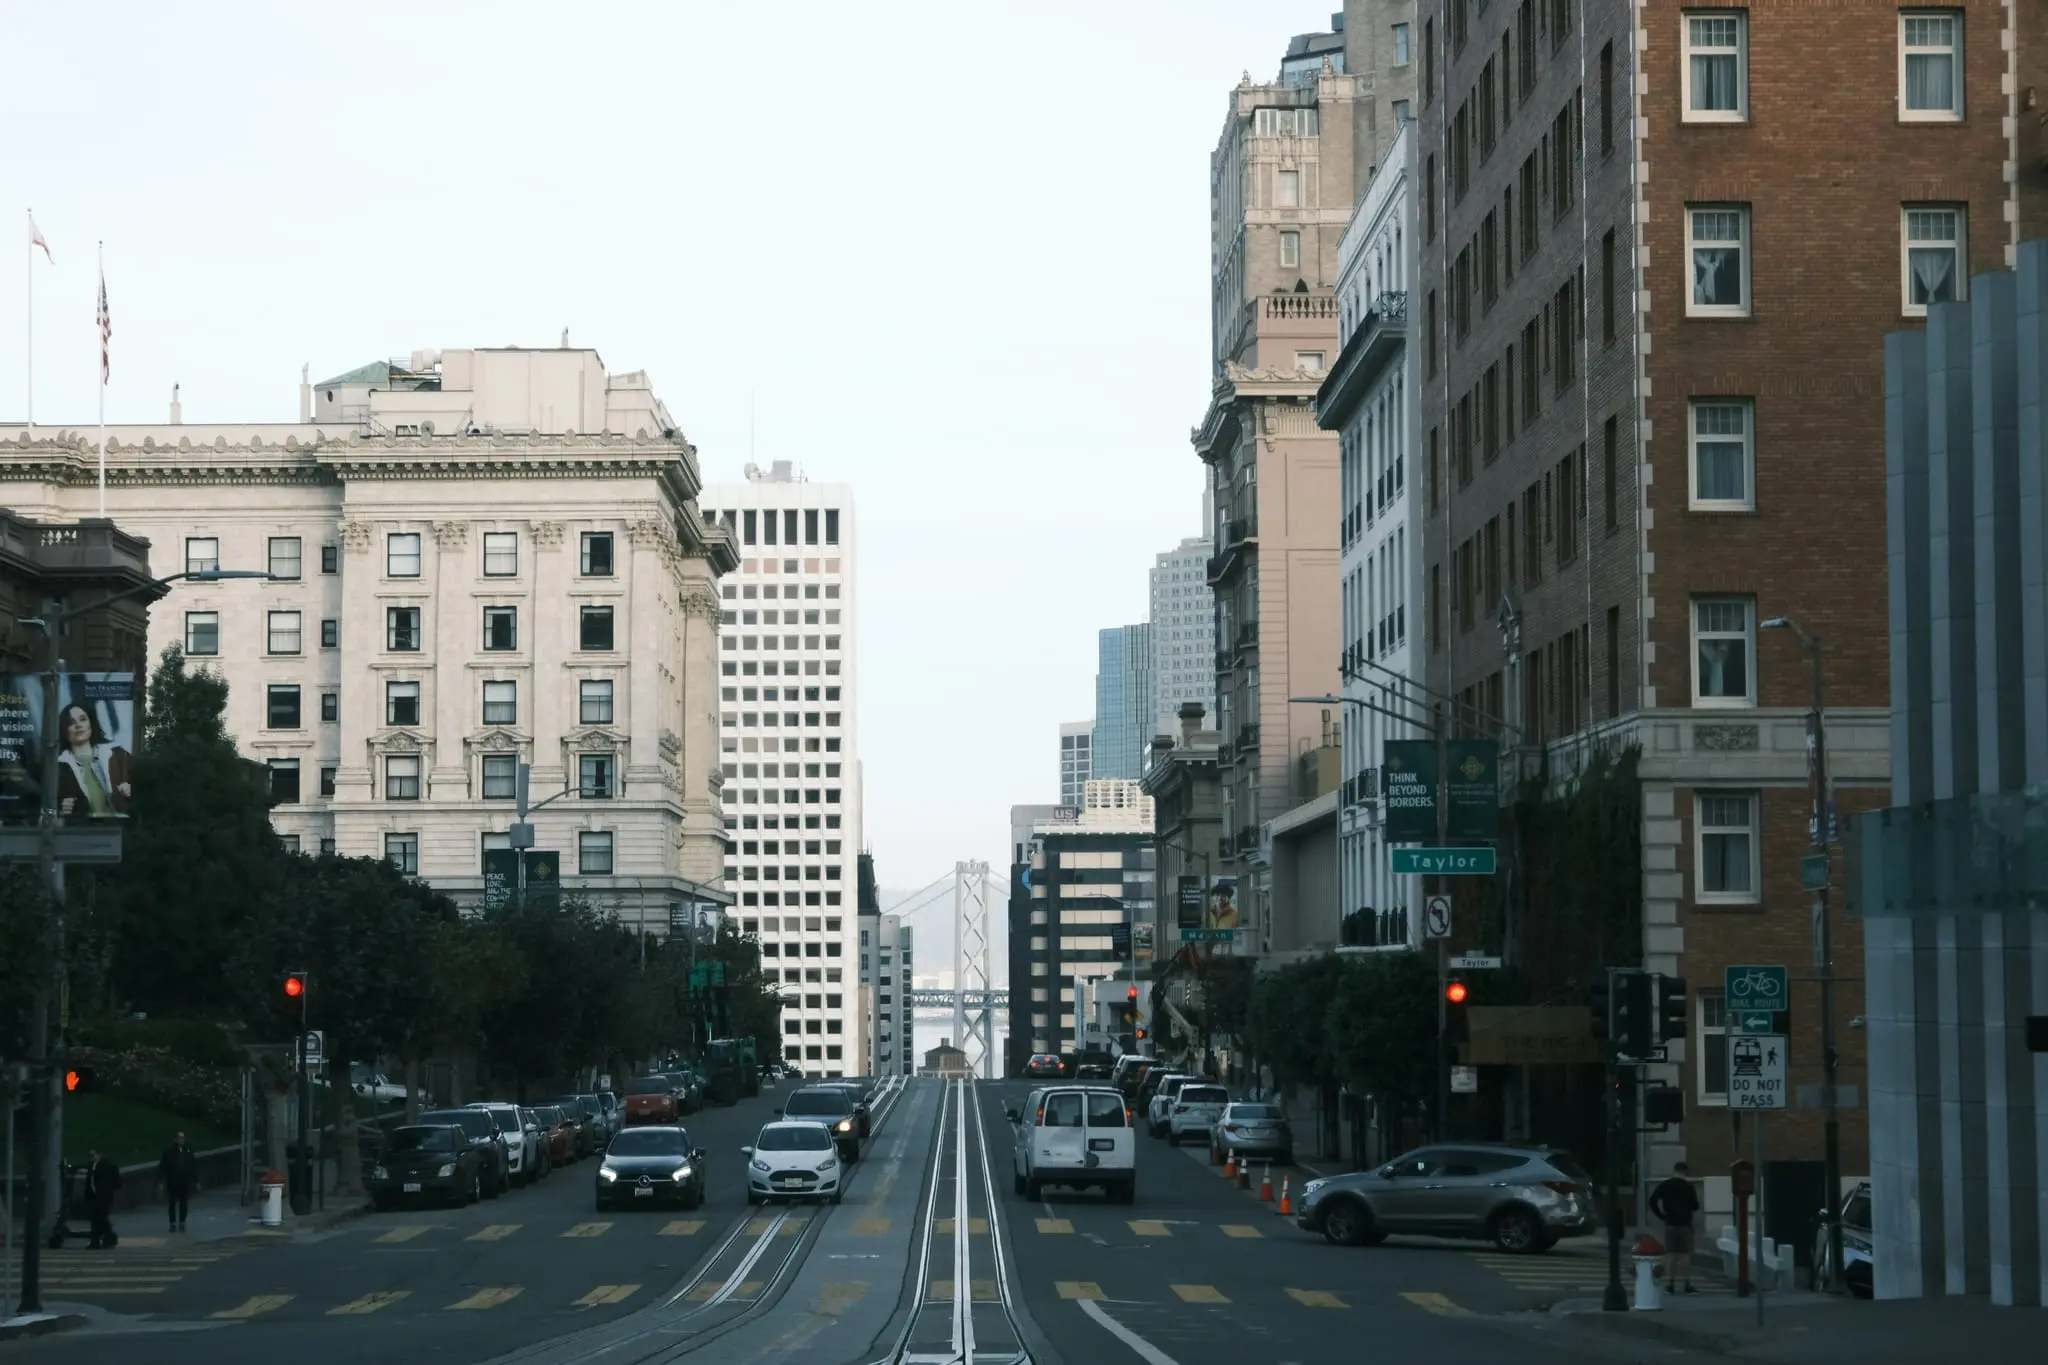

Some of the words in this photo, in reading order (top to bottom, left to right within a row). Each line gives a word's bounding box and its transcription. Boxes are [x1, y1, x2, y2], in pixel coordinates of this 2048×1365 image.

[2, 721, 34, 732] vision
[1388, 773, 1417, 783] THINK
[1389, 785, 1427, 795] BEYOND
[1390, 797, 1435, 808] BORDERS.
[1410, 855, 1477, 871] Taylor
[1189, 932, 1227, 940] Man
[1462, 959, 1489, 967] Taylor
[1733, 1079, 1750, 1091] DO
[1757, 1079, 1781, 1091] NOT
[1741, 1094, 1773, 1106] PASS
